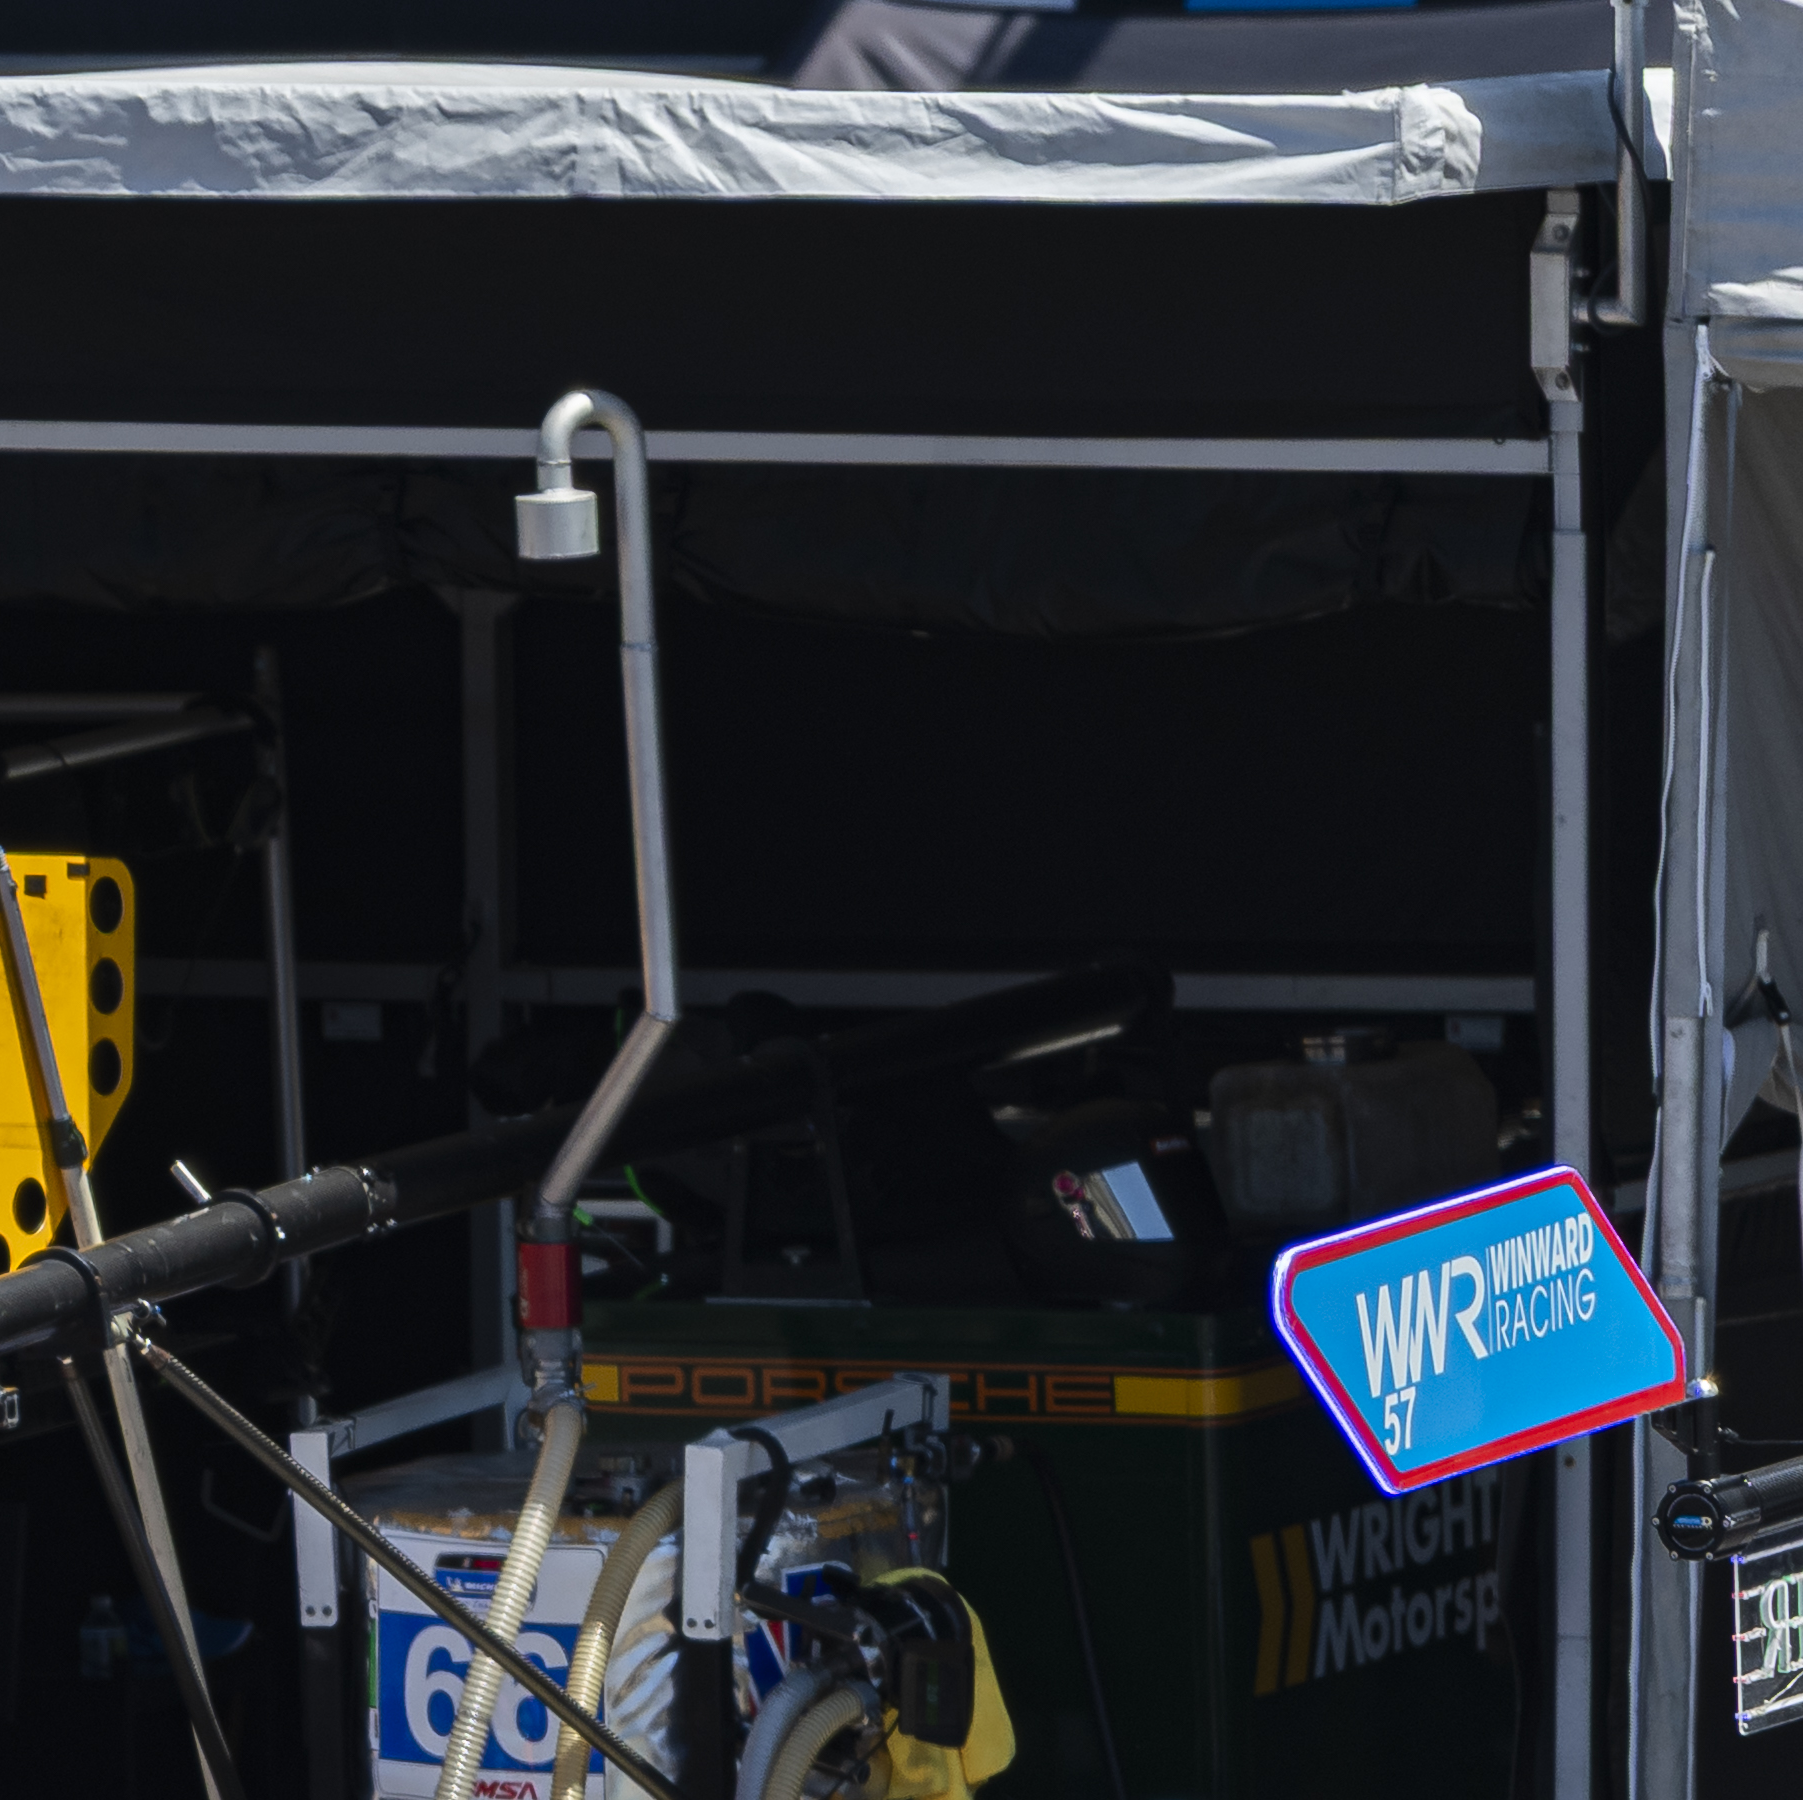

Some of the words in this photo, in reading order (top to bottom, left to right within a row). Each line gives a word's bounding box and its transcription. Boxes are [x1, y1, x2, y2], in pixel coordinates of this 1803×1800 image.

[1490, 1212, 1595, 1296] WINWARD
[1495, 1268, 1597, 1352] RACING
[621, 1365, 1113, 1413] PORHE
[1383, 1385, 1417, 1457] 57
[1310, 1474, 1499, 1592] WRIGHT
[403, 1624, 569, 1767] 66
